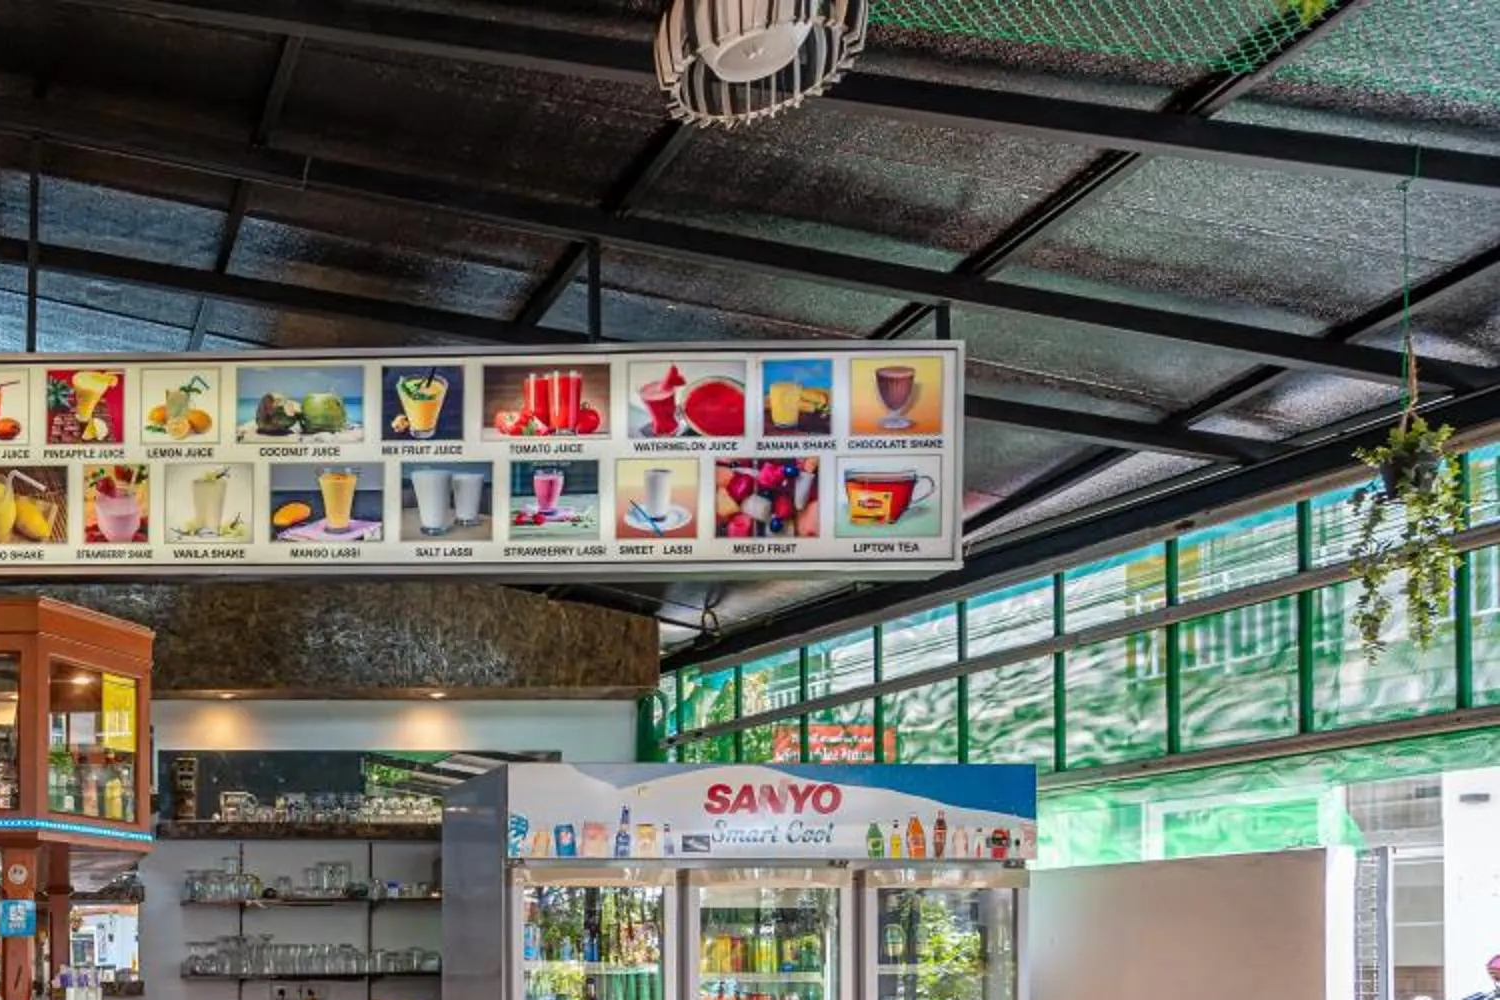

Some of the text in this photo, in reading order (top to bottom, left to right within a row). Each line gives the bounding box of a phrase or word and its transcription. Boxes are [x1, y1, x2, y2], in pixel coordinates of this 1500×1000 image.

[509, 443, 584, 454] TOMATO JUICE
[634, 441, 739, 452] WATERMELON JUICE
[756, 439, 837, 450] BANANA SHAKE
[847, 438, 944, 449] CHOCOLATE SHAKE
[1, 449, 30, 459] JUICE
[43, 449, 125, 459] PINEAPPLE JUICE
[147, 448, 213, 459] LEMON JUICE
[259, 447, 340, 457] COCONUT JUICE
[381, 445, 463, 455] MIX FRUIT JUICE
[415, 547, 473, 557] SALT LASSI
[503, 546, 607, 557] STRAWBERRY LASSI
[619, 545, 693, 555] SWEET LASSI
[732, 543, 797, 554] MIXED FRUIT
[853, 543, 919, 553] LIPTON TEA
[9, 550, 44, 560] SHAKE
[76, 549, 153, 559] STRAWBERRY SHAKE
[173, 549, 245, 559] VANILA SHAKE
[290, 548, 361, 559] MANGO LASSI
[704, 783, 843, 815] SANYO
[711, 819, 835, 844] Smart Cool
